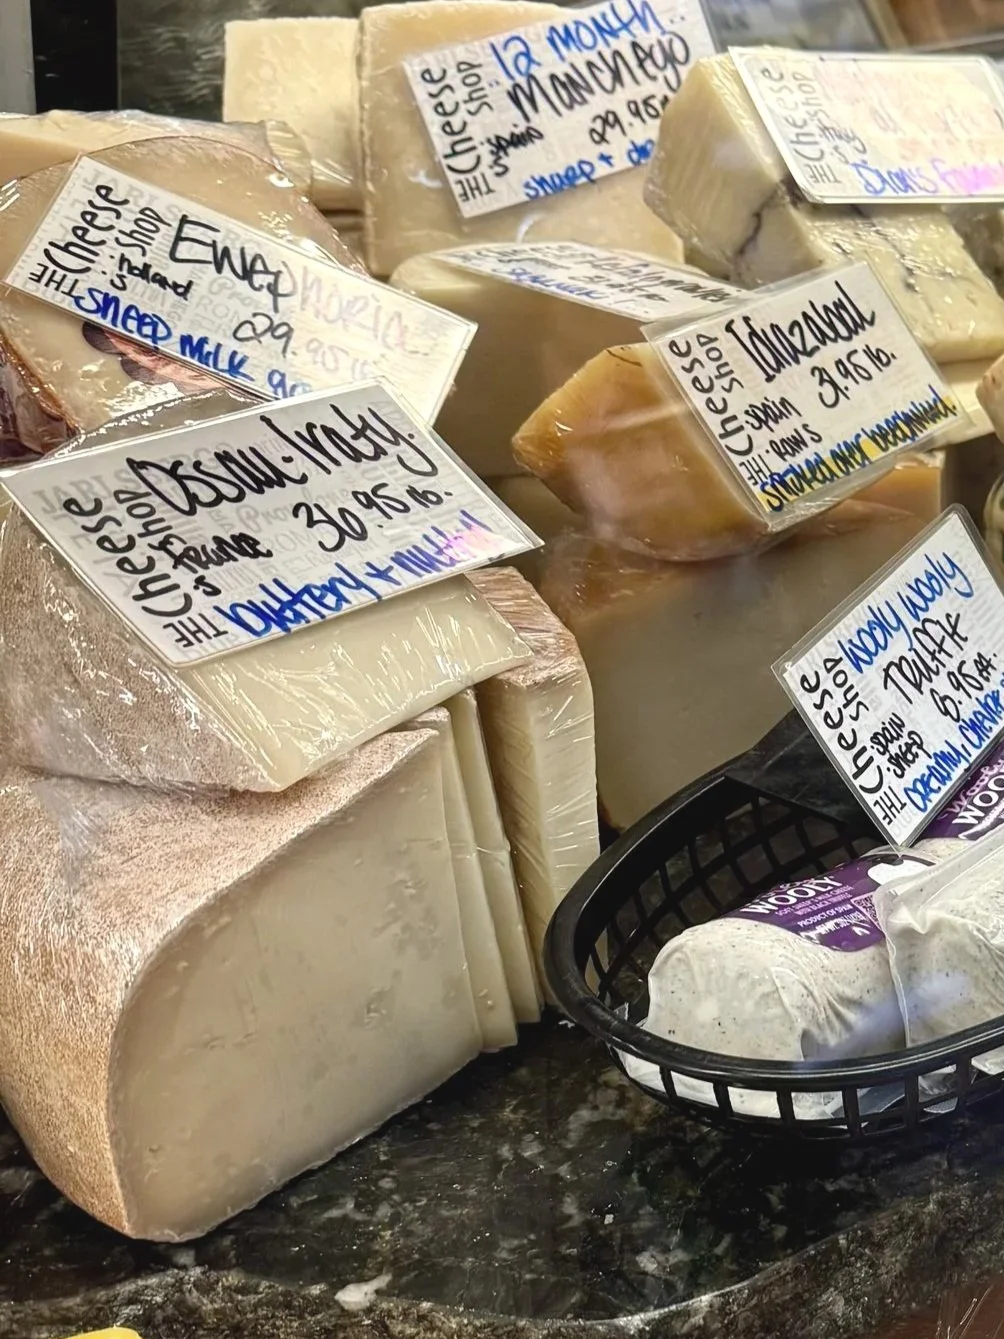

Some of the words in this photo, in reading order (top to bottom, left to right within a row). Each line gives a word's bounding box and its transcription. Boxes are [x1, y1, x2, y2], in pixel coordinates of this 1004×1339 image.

[490, 36, 541, 80] 12
[421, 67, 481, 175] Cheese
[458, 172, 496, 202] THE
[44, 185, 130, 275] Cheese
[30, 263, 81, 297] THE
[668, 338, 754, 457] Cheese
[738, 455, 774, 487] THE
[63, 496, 193, 618] Cheese
[162, 611, 228, 648] THE
[799, 668, 884, 794] Cheese
[873, 784, 907, 826] THE
[740, 876, 843, 914] WOOLY
